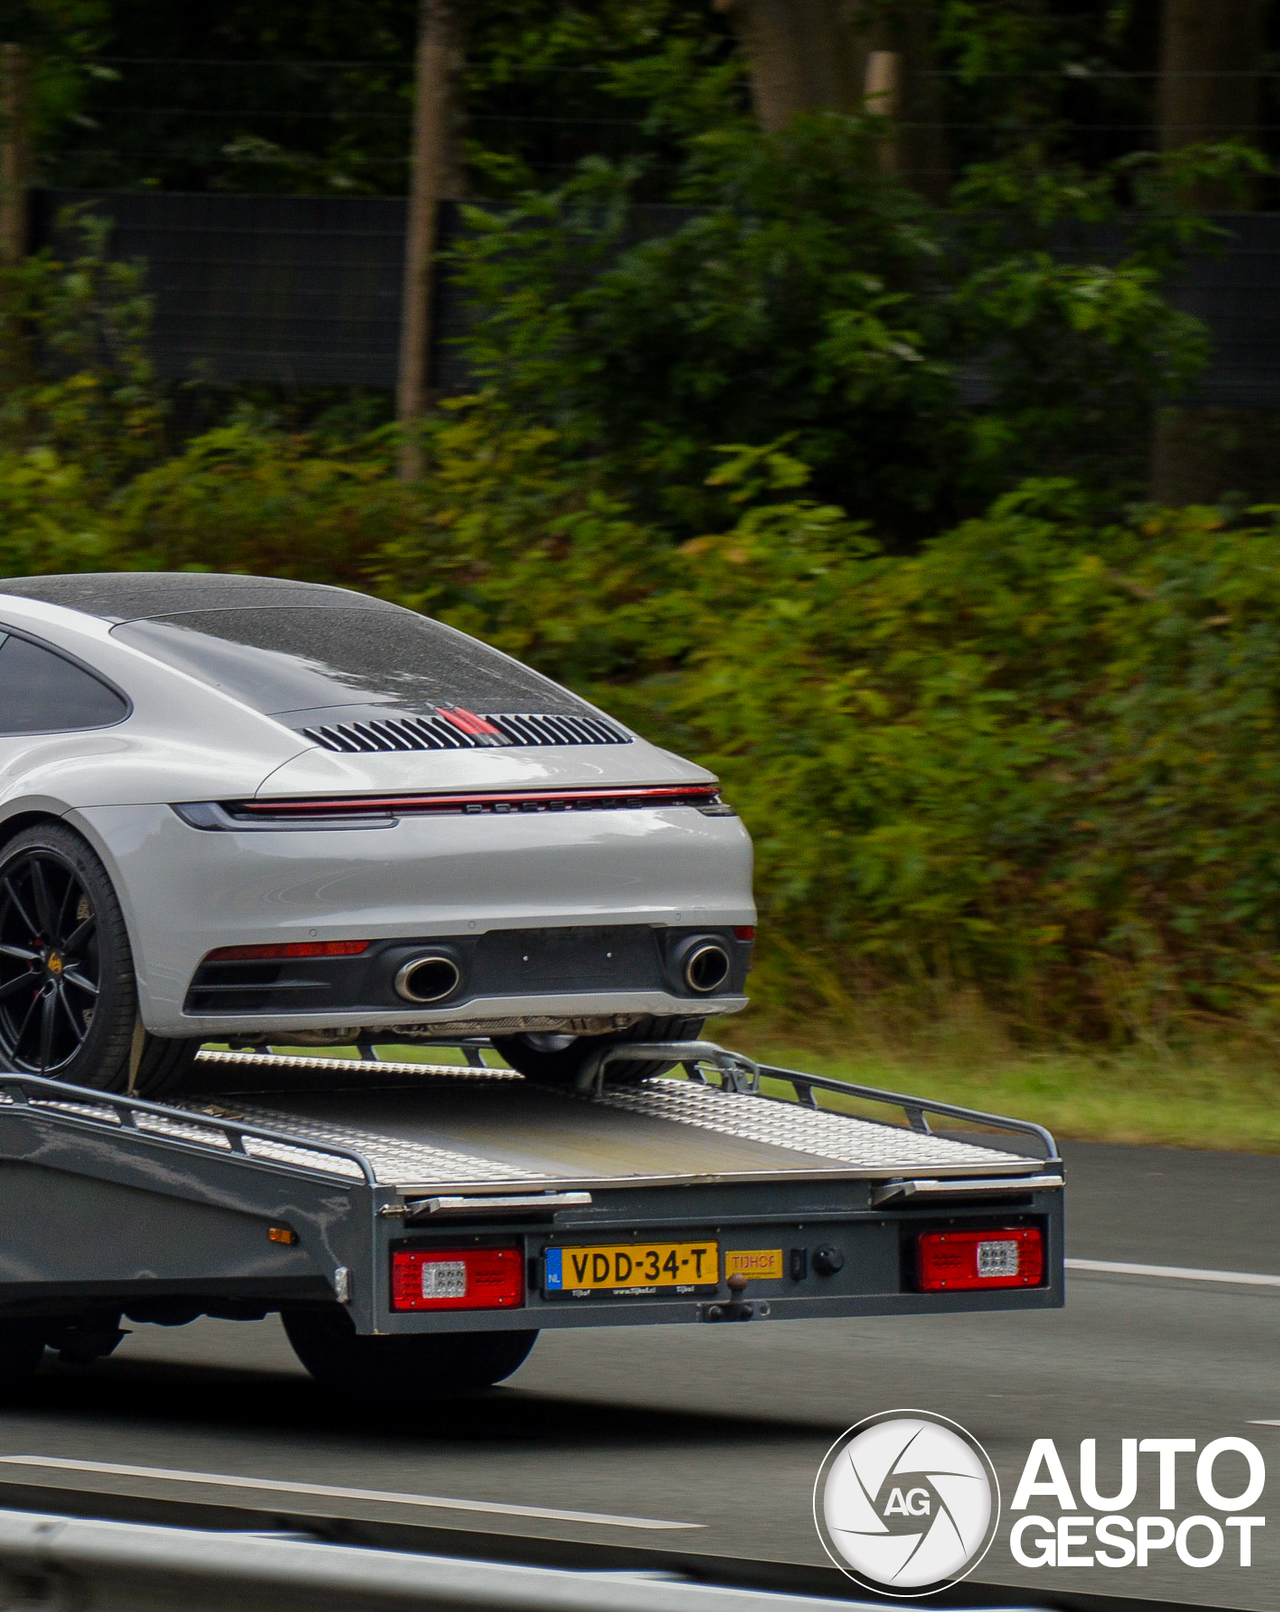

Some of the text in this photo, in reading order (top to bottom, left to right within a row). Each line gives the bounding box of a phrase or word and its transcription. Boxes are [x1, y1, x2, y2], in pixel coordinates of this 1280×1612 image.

[571, 1248, 707, 1284] VDD-34-T
[731, 1255, 776, 1269] TIJHOF
[548, 1274, 561, 1284] NL
